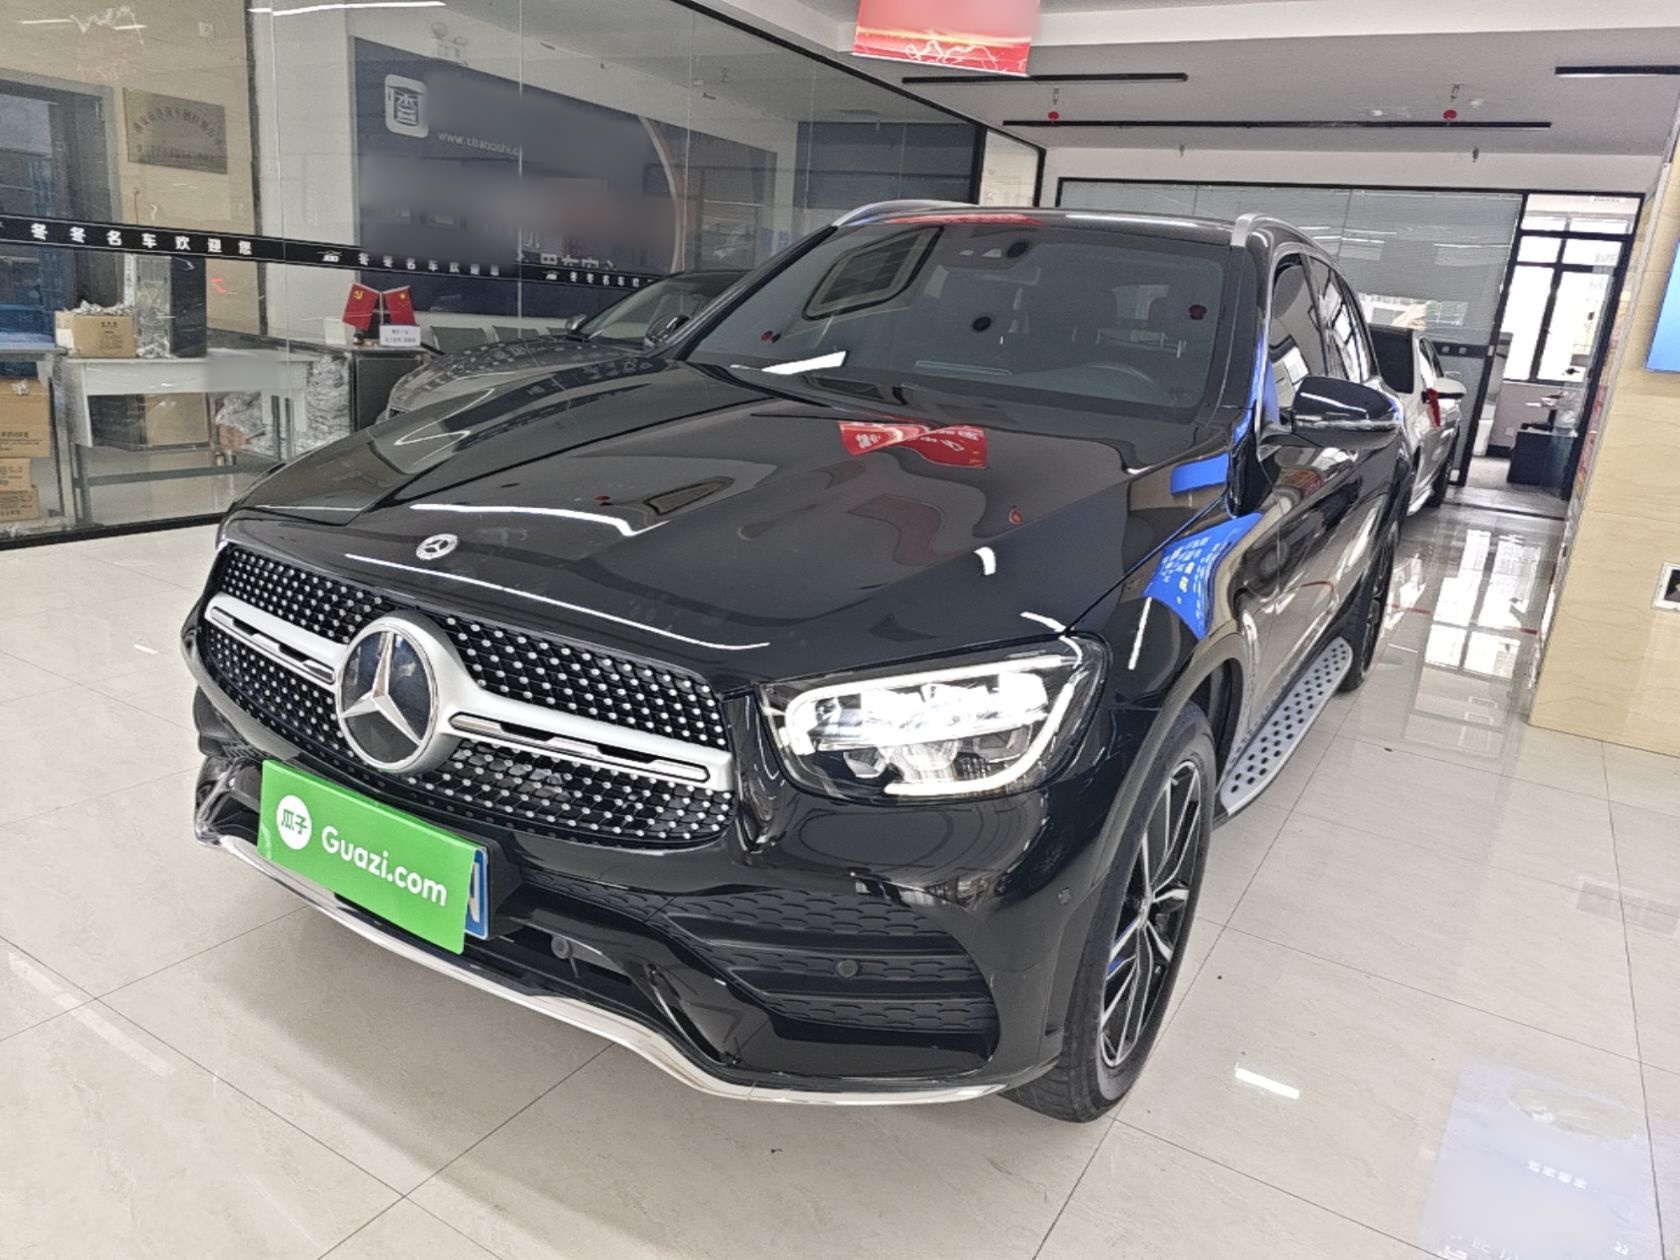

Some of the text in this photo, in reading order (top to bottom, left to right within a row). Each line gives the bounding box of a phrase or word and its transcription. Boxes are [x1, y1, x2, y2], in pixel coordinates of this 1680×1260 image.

[30, 222, 253, 255] 冬冬名车欢迎您
[281, 808, 309, 835] 瓜子
[321, 825, 448, 907] Guazi.com
